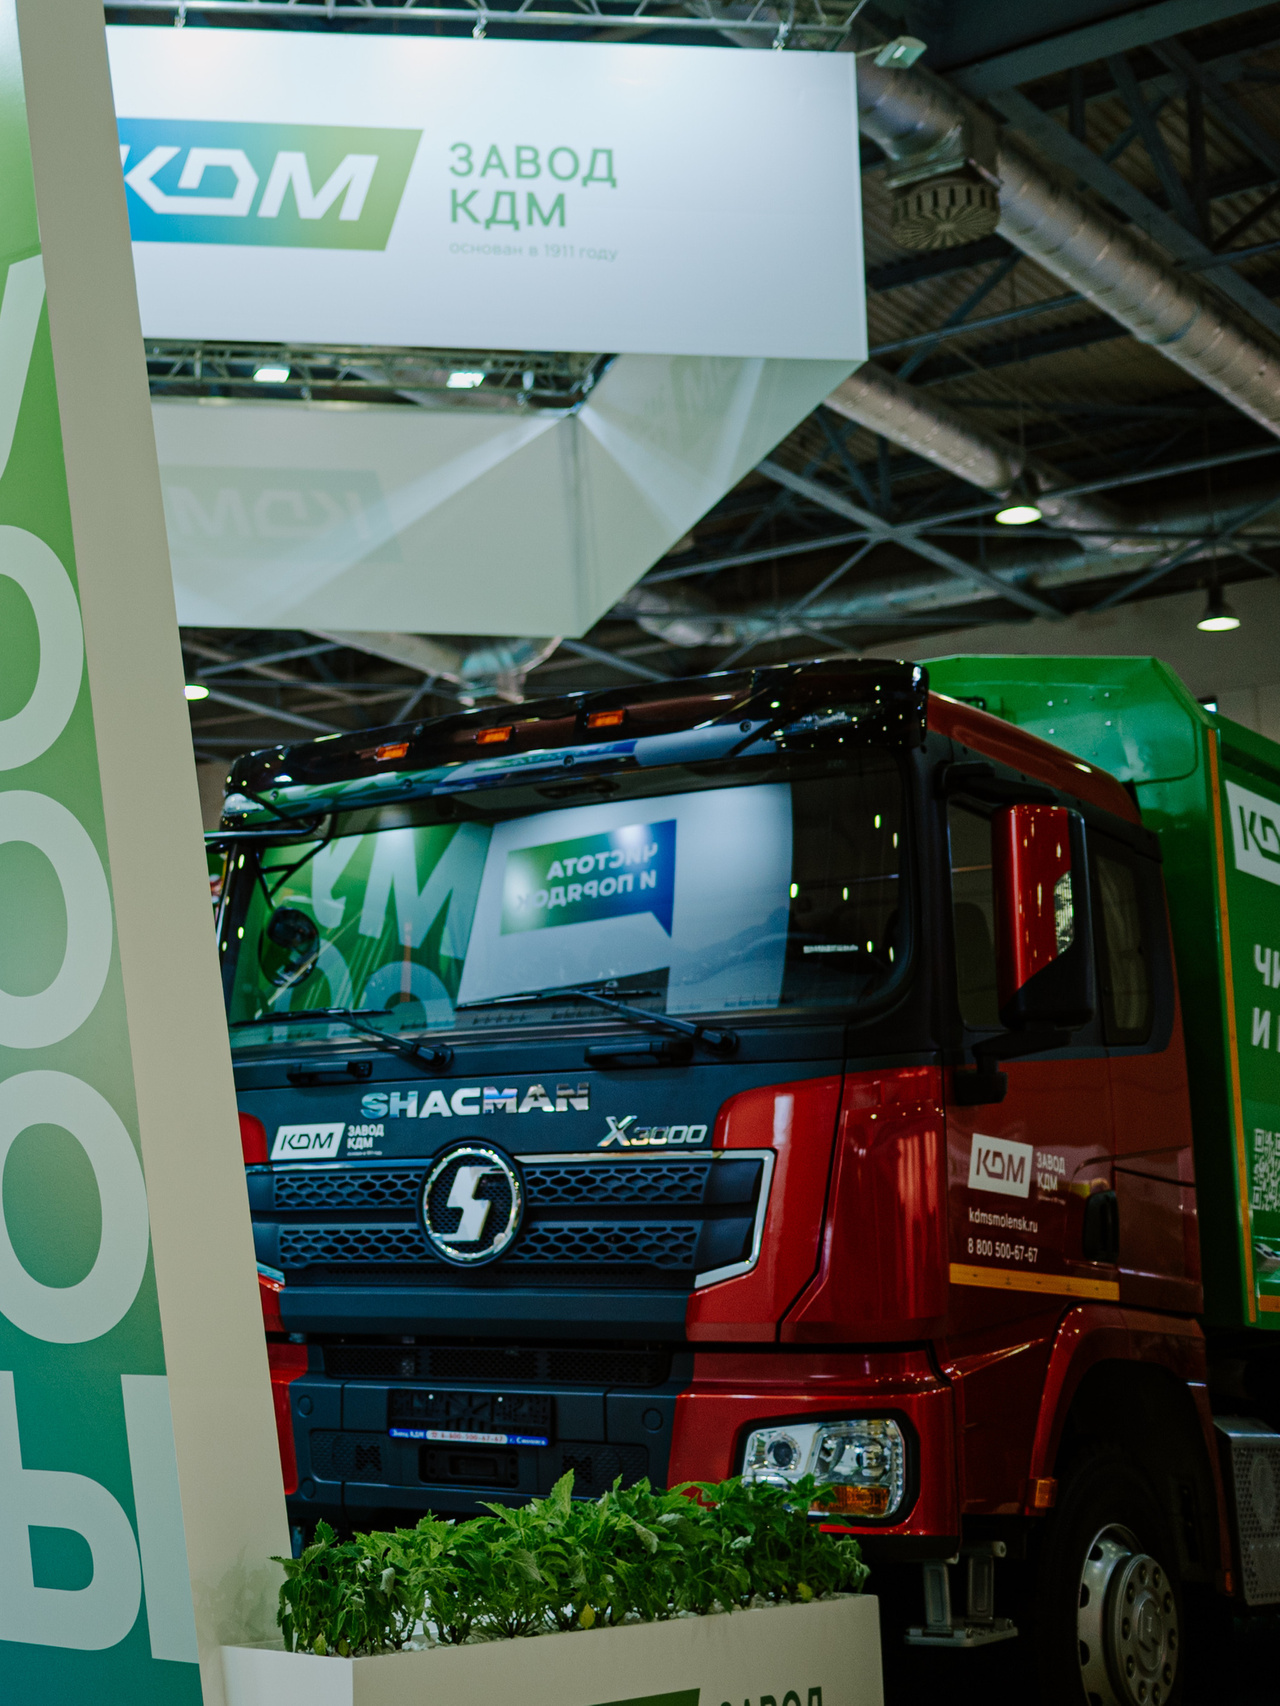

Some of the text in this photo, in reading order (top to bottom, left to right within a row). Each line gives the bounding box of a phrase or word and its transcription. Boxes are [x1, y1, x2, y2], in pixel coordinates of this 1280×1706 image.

[449, 142, 617, 188] ЗАВОД
[450, 189, 566, 231] КДМ
[449, 242, 619, 262] основан в 1911 году
[361, 1082, 589, 1119] SHACMAN
[281, 1132, 334, 1151] KDM
[347, 1124, 385, 1138] ЗАВОД
[347, 1137, 373, 1151] КДМ
[597, 1115, 708, 1148] X3000
[976, 1148, 1026, 1184] KDM
[1036, 1152, 1066, 1175] ЗАВОД
[1037, 1172, 1058, 1192] КДМ
[969, 1207, 1038, 1233] kdmsmolensk.ru
[968, 1237, 1038, 1263] 8 800 500-67-67
